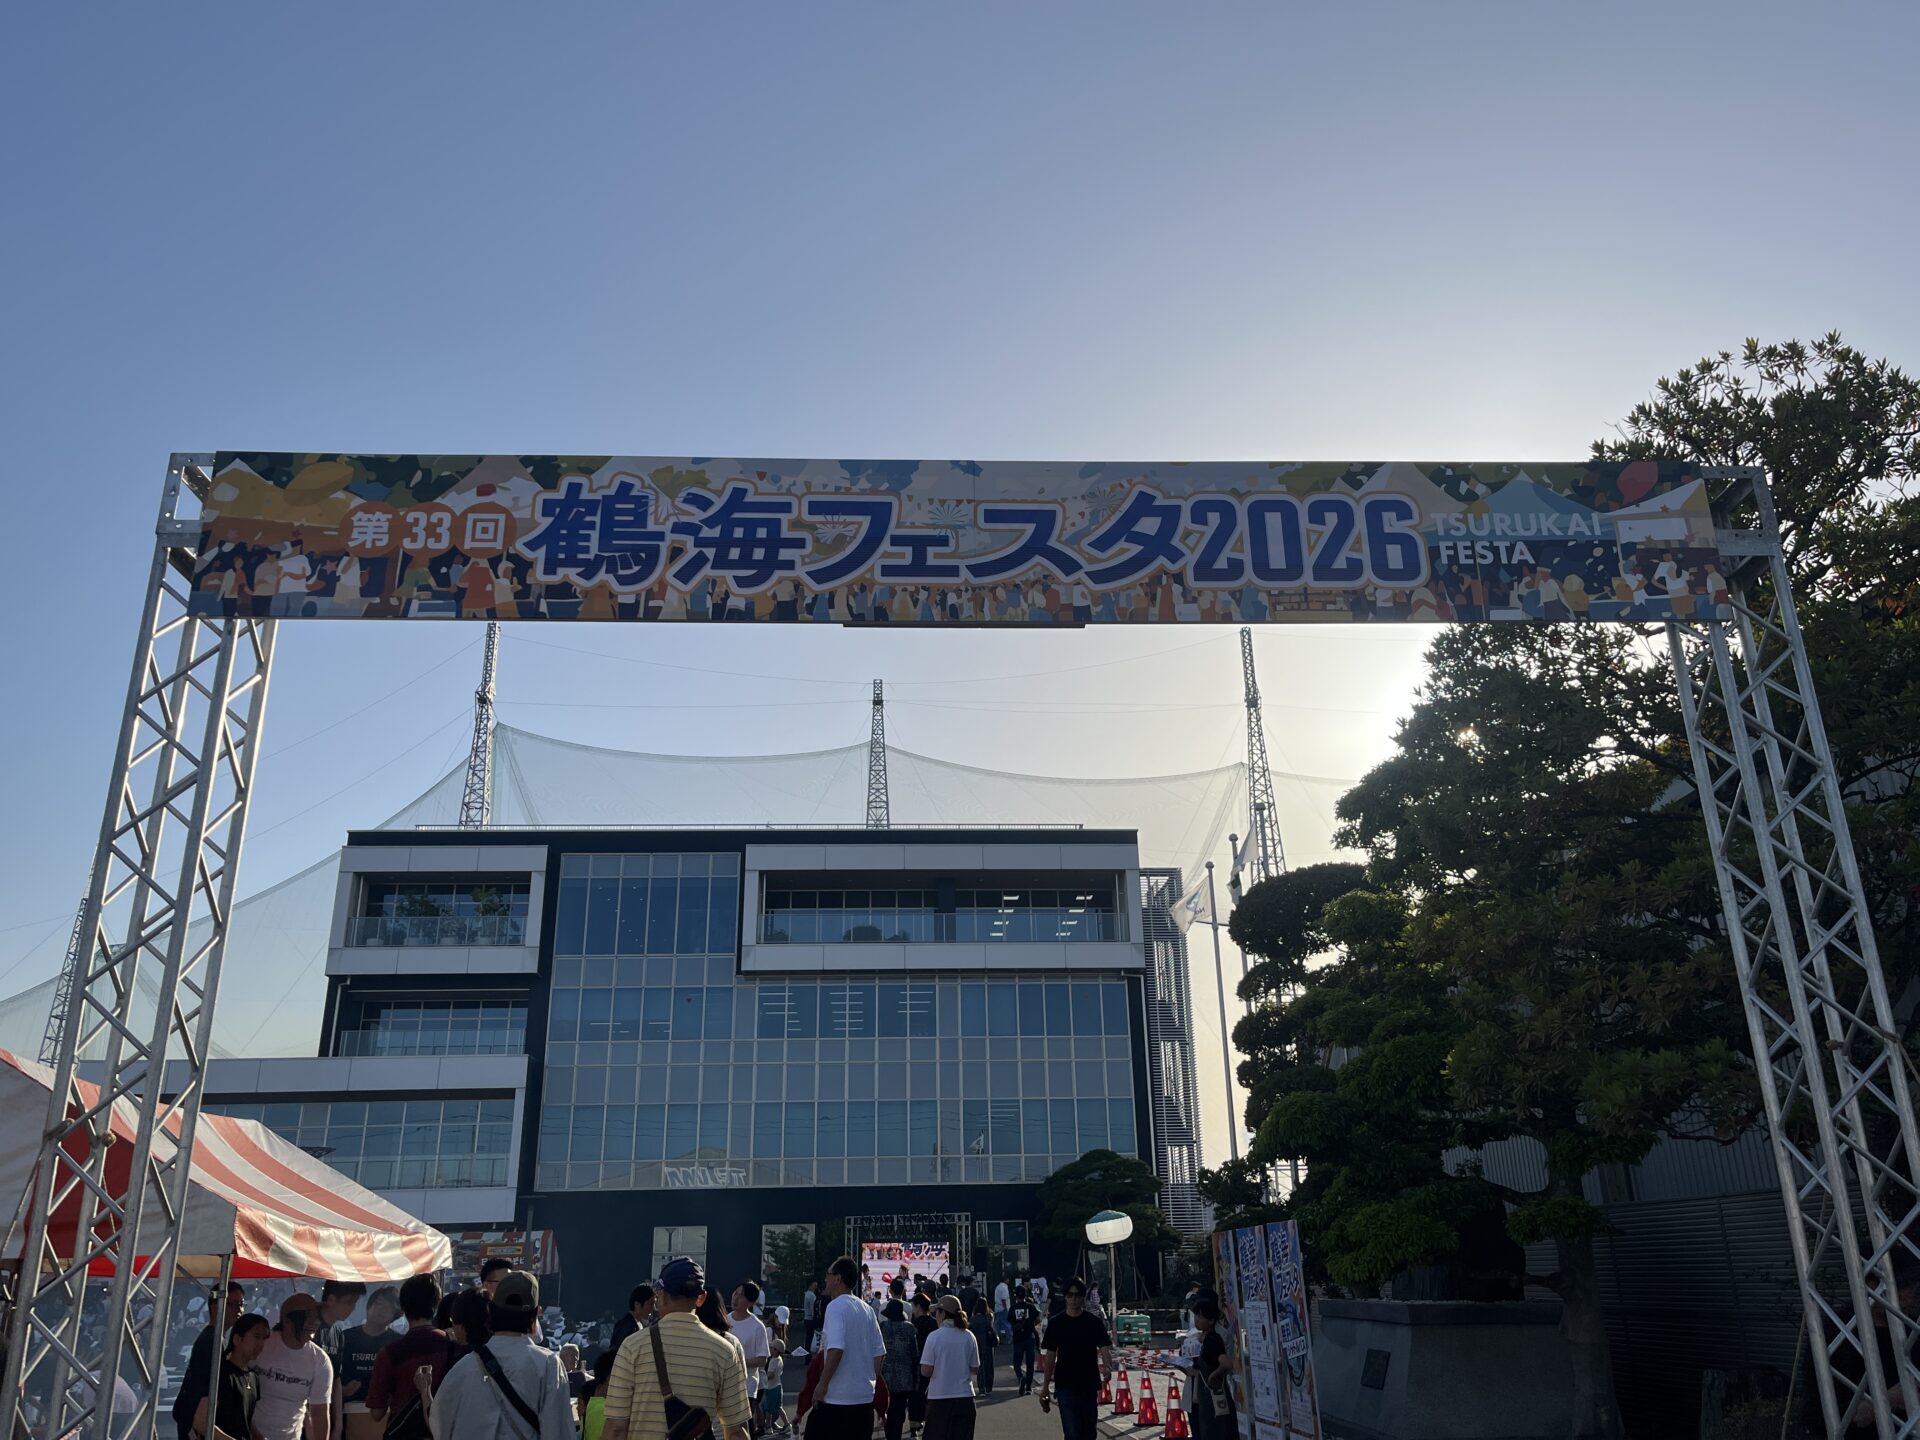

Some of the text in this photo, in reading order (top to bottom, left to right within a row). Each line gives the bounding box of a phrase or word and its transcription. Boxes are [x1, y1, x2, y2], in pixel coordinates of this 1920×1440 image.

[349, 511, 507, 550] 第33回
[1430, 512, 1602, 537] TSURUKAI
[1438, 541, 1537, 566] FESTA
